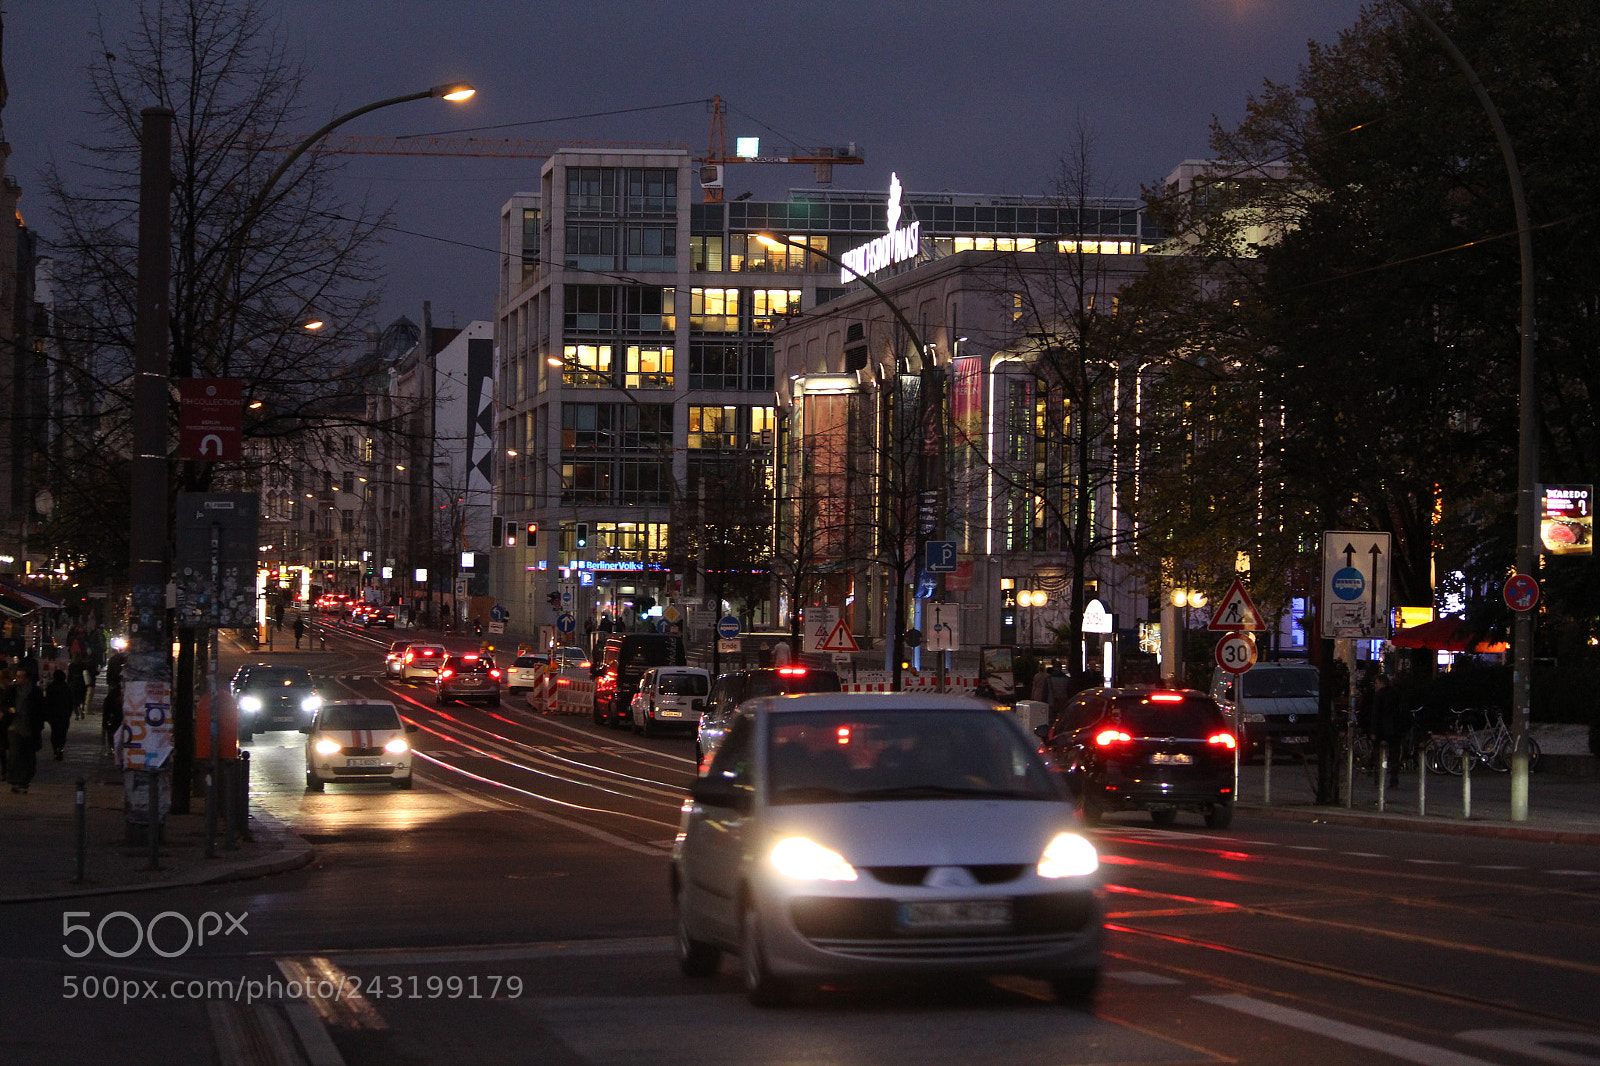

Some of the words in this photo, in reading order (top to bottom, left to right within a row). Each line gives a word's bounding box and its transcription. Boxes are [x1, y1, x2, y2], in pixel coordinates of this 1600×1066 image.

[194, 398, 242, 406] COLLECTION
[942, 549, 952, 565] P
[586, 561, 618, 570] Berliner
[721, 642, 737, 650] Ende
[1225, 645, 1247, 663] 30
